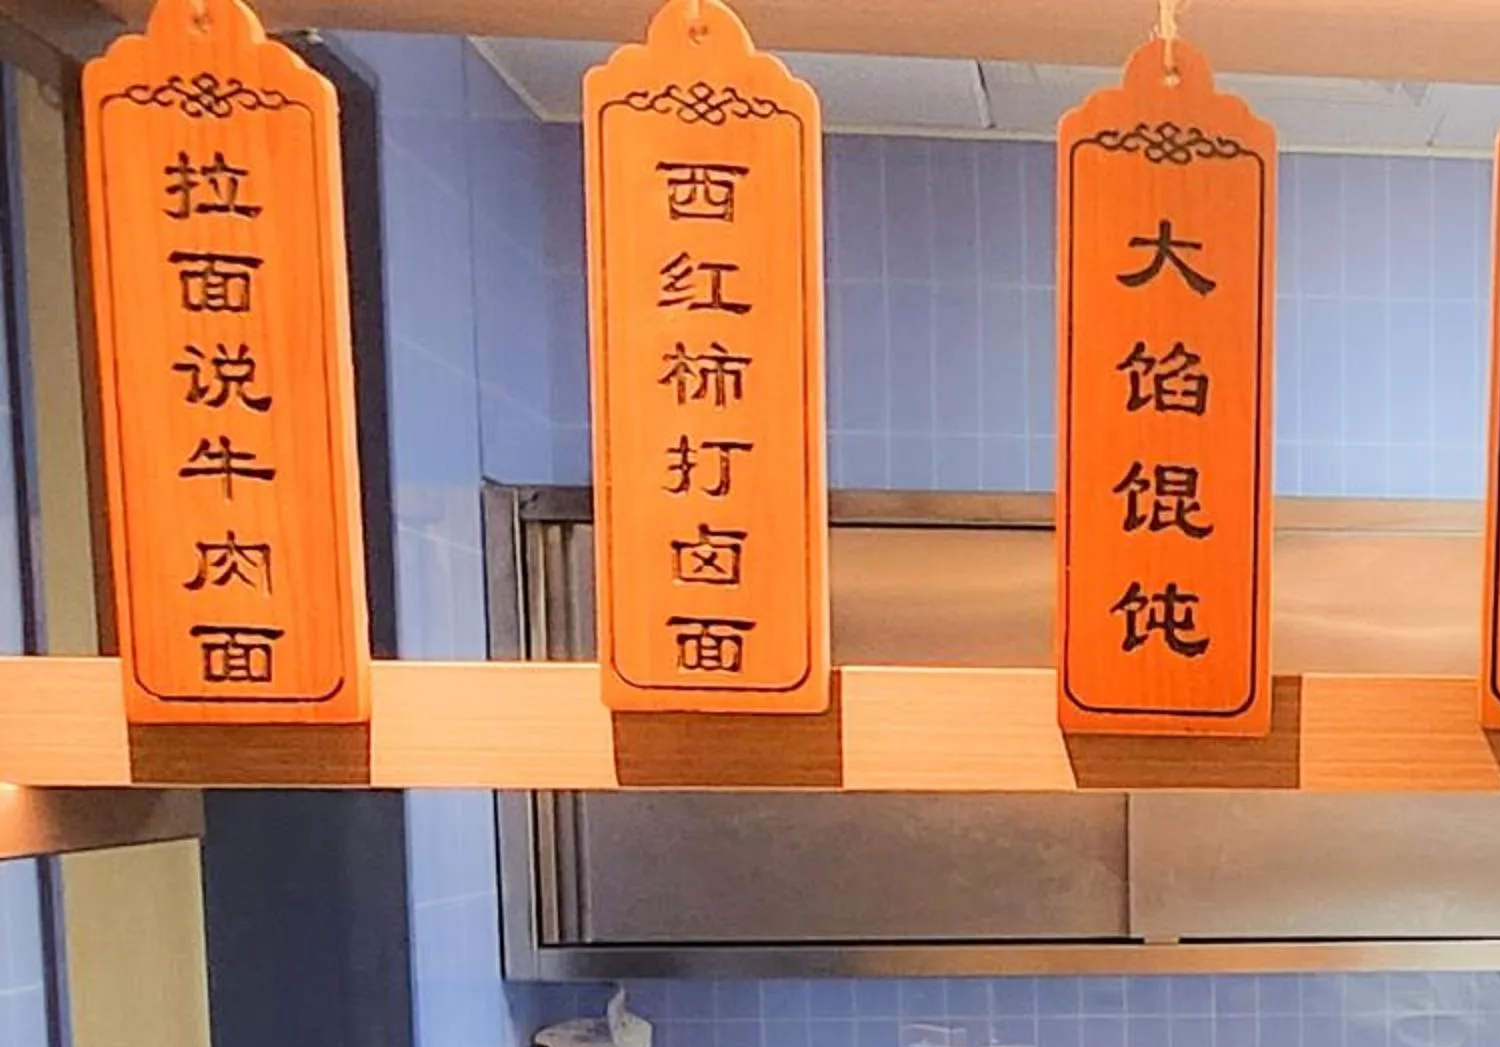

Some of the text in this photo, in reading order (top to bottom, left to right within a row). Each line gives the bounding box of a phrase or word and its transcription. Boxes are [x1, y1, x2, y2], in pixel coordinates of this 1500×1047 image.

[163, 151, 285, 684] 拉面说牛肉面
[655, 161, 757, 673] 西红柿打卤面
[1109, 218, 1217, 658] 大馅馄饨
